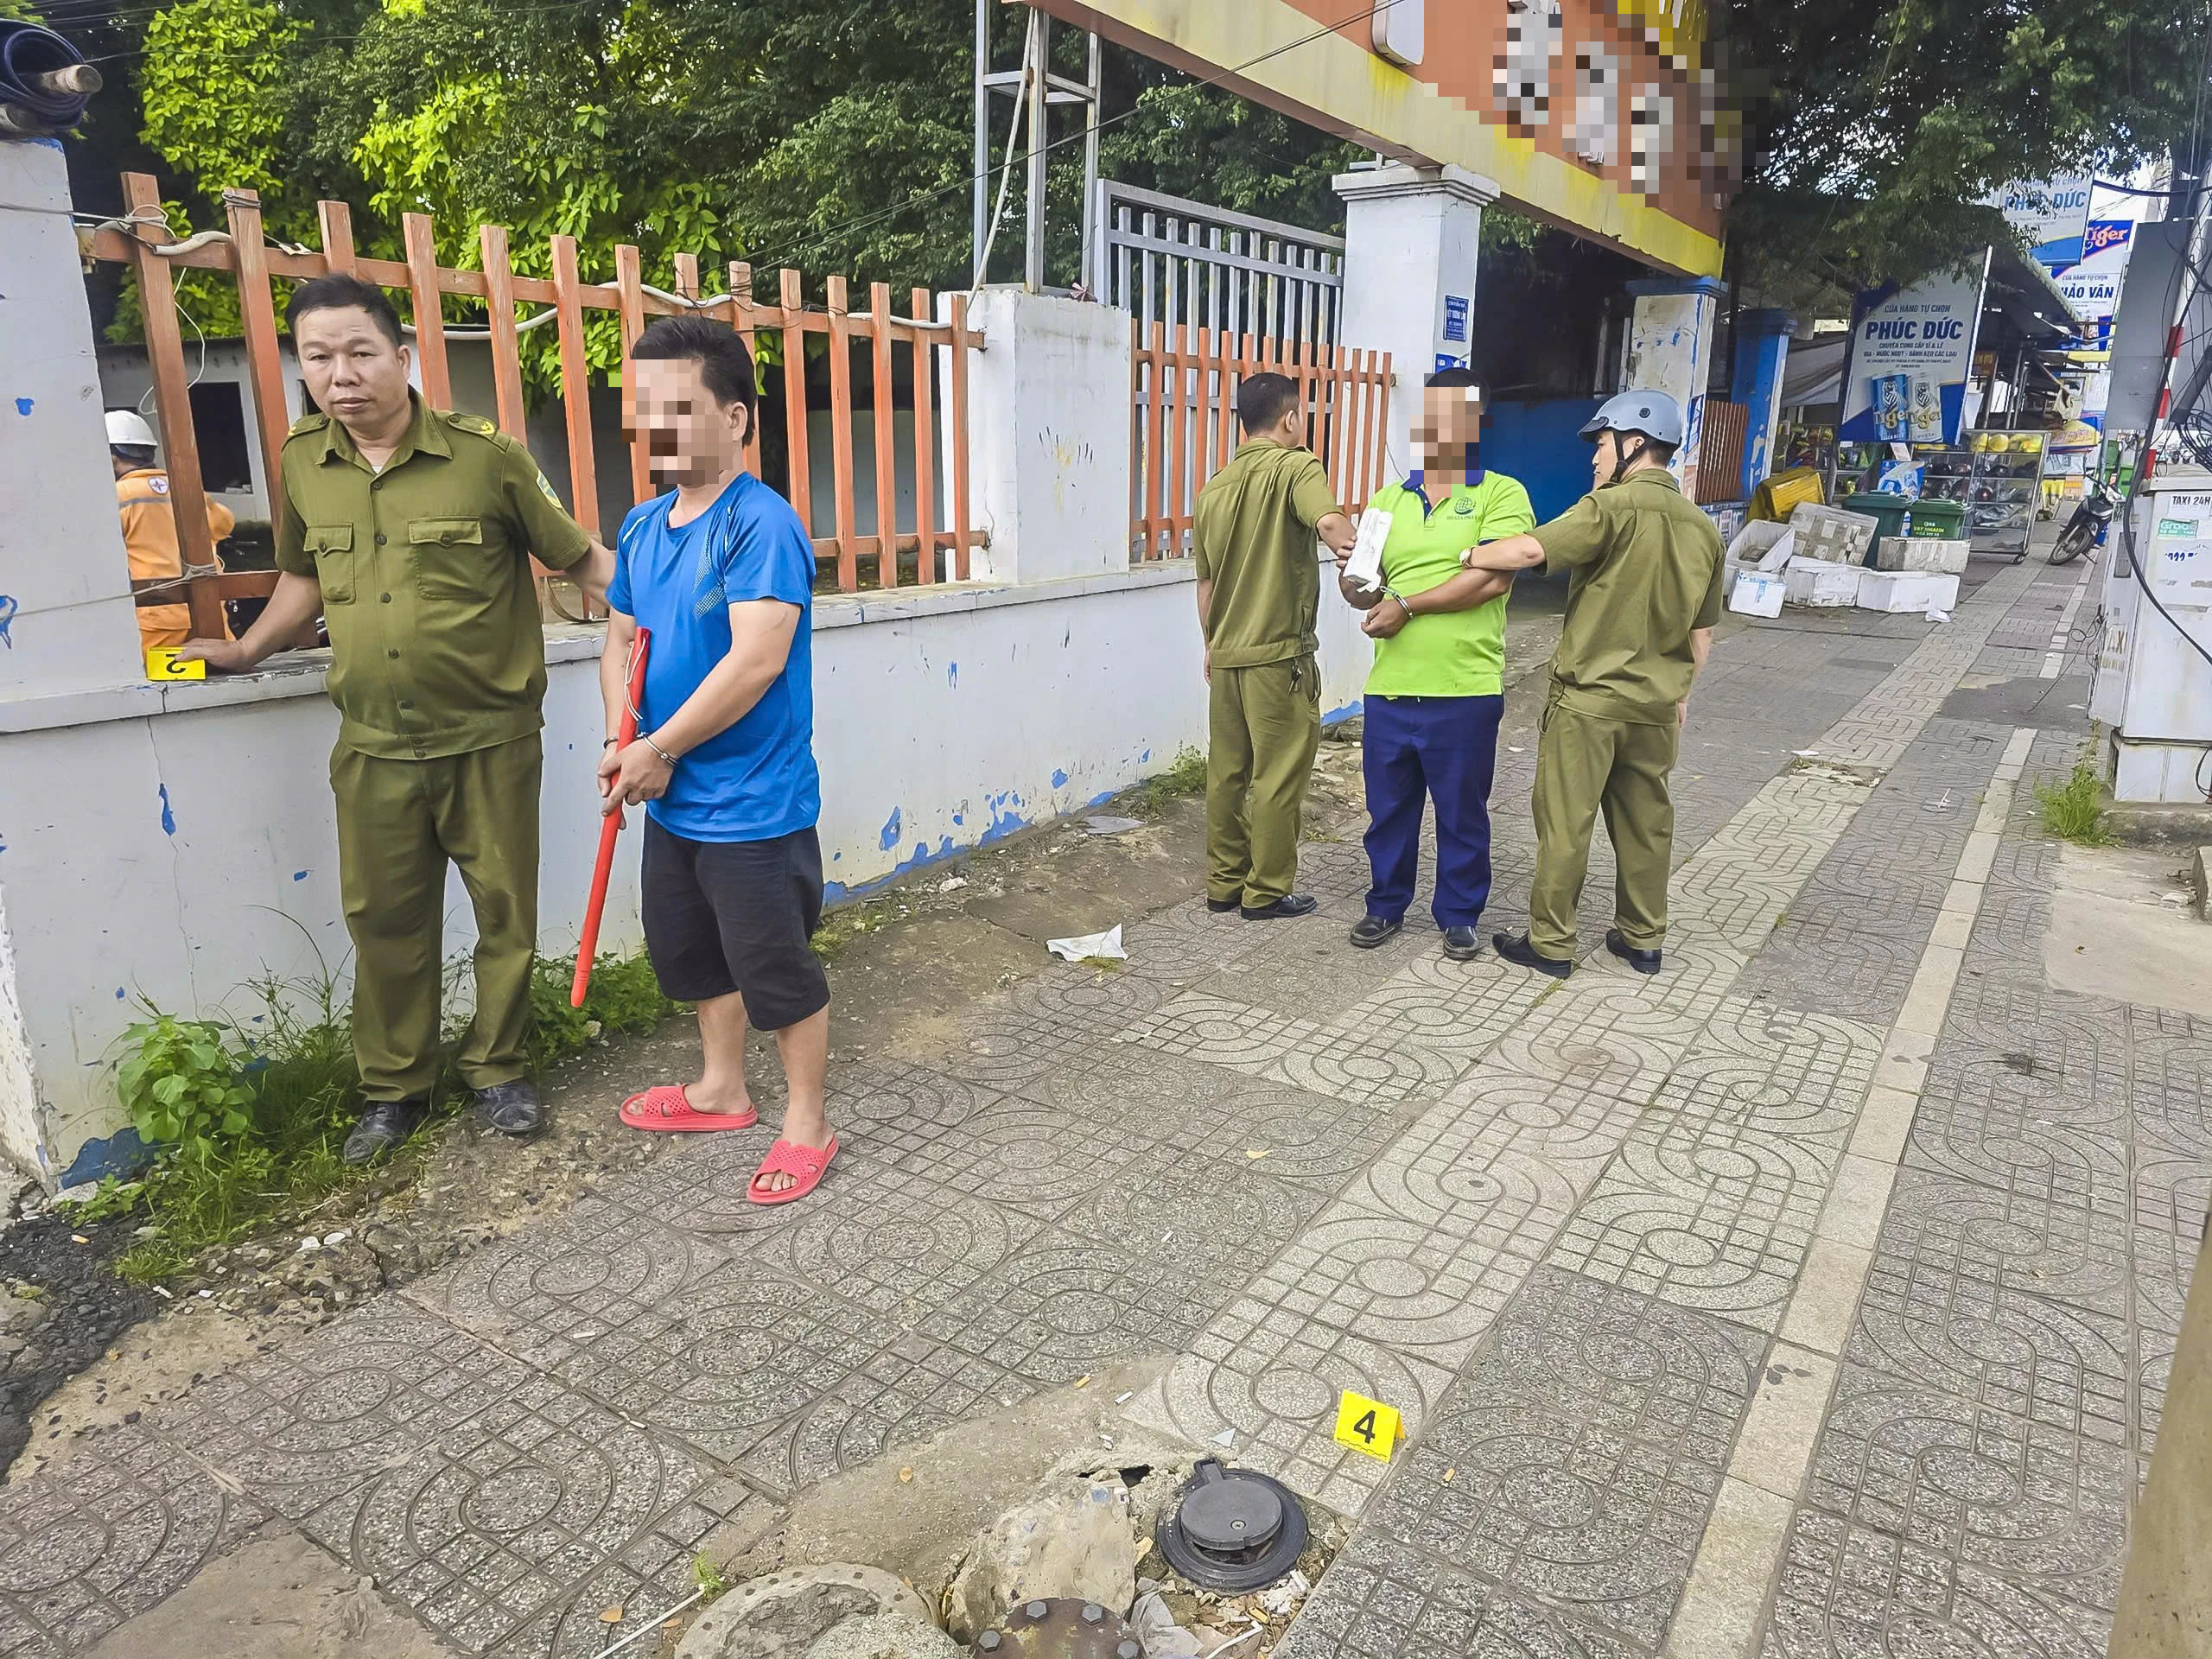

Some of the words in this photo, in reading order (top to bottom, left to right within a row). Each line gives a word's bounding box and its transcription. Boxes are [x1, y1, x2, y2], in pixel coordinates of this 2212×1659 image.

[2086, 226, 2129, 247] Tiger
[1866, 316, 1917, 340] PHÚC
[1923, 316, 1964, 340] ĐỨC
[2172, 496, 2191, 505] TAXI
[2193, 496, 2211, 505] 24H
[1353, 1409, 1376, 1444] 4
